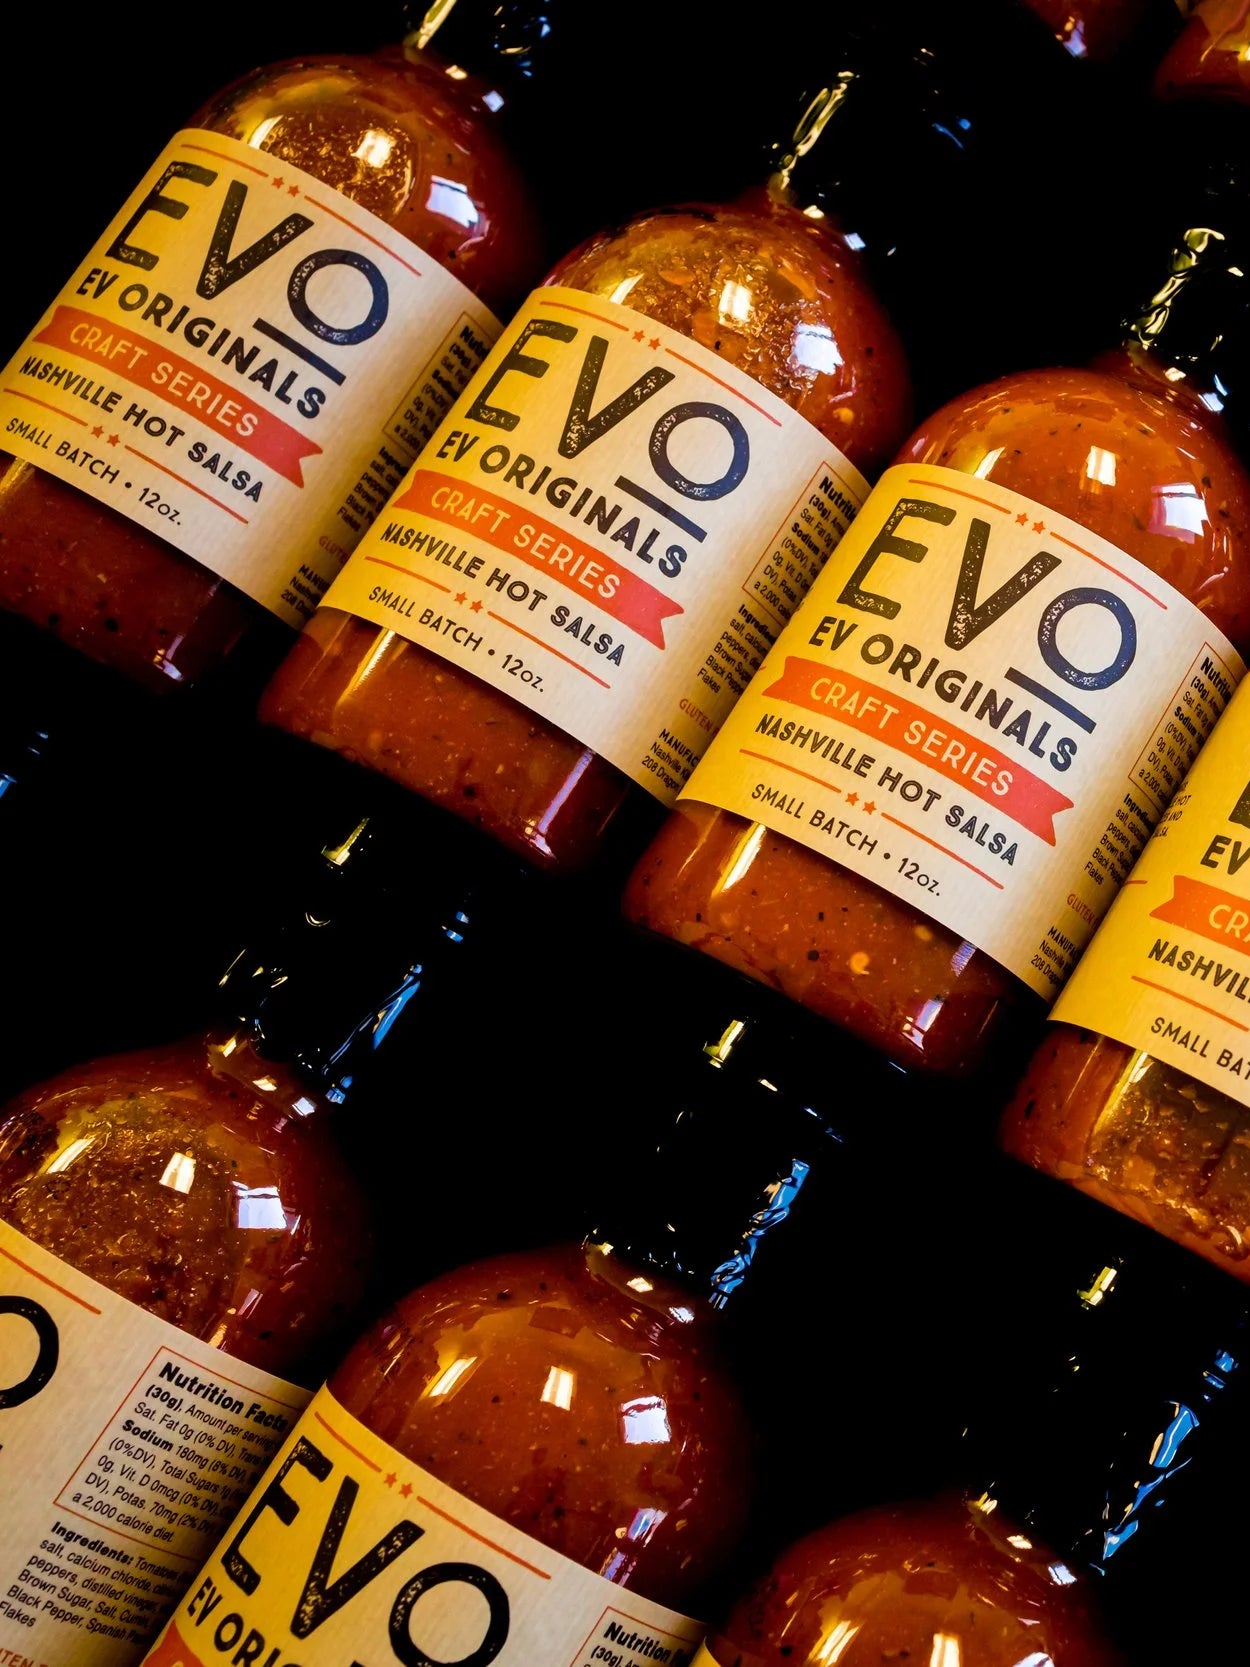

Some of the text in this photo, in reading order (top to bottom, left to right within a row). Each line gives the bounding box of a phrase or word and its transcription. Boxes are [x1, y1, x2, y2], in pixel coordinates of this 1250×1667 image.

[105, 161, 389, 346] EVO
[76, 268, 113, 300] EV
[117, 283, 327, 420] ORIGINALS
[69, 323, 259, 437] CRAFT SERIES
[19, 357, 264, 503] NASHVILLE HOT SALSA
[464, 319, 750, 501] EVO
[5, 418, 51, 450] SMALL
[56, 439, 119, 485] BATCH
[436, 431, 475, 462] EV
[479, 444, 687, 578] ORIGINALS
[801, 509, 814, 525] Sat.
[430, 487, 511, 533] CRAFT
[512, 525, 621, 599] SERIES
[791, 523, 821, 555] Sodium
[368, 586, 412, 619] SMALL
[418, 609, 483, 652] BATCH
[380, 522, 483, 578] NASHVILLE
[487, 567, 547, 612] HOT
[550, 606, 624, 667] SALSA
[836, 498, 1138, 691] EVO
[721, 632, 749, 660] peppers,
[697, 668, 721, 693] Flakes
[808, 616, 1080, 773] EV ORIGINALS
[679, 699, 713, 732] GLUTEN
[809, 679, 1014, 797] CRAFT SERIES
[642, 756, 657, 772] 208
[650, 743, 682, 774] Nashville
[659, 728, 700, 767] MANUFAC
[755, 713, 1019, 867] NASHVILLE HOT SALSA
[751, 783, 802, 820] SMALL
[809, 809, 878, 857] BATCH
[1084, 862, 1104, 884] Flakes
[1151, 1017, 1210, 1059] SMALL
[145, 1385, 243, 1436] (30g), Amount per
[159, 1362, 288, 1432] Nutrition Facts
[122, 1420, 227, 1475] Sodium 180mg (8%
[135, 1402, 155, 1421] Sat.
[160, 1414, 180, 1432] Fat
[180, 1427, 194, 1440] 0g
[194, 1431, 215, 1448] (0%
[98, 1455, 199, 1508] 0g, Vit. D 0mcg (0%
[109, 1437, 219, 1494] (0%DV), Total Sugars
[73, 1492, 174, 1543] a 2,000 calorie diet.
[85, 1472, 178, 1523] DV), Potas. 70mg
[40, 1539, 64, 1559] salt,
[67, 1551, 110, 1576] calcium
[51, 1522, 134, 1566] Ingredients:
[221, 1435, 510, 1667] EVO
[18, 1568, 116, 1620] Brown Sugar, Salt,
[27, 1555, 123, 1600] peppers, distilled
[187, 1576, 223, 1627] EV
[0, 1601, 36, 1627] Flakes
[7, 1585, 129, 1640] Black Pepper, Spanish
[604, 1621, 670, 1662] Nutrition
